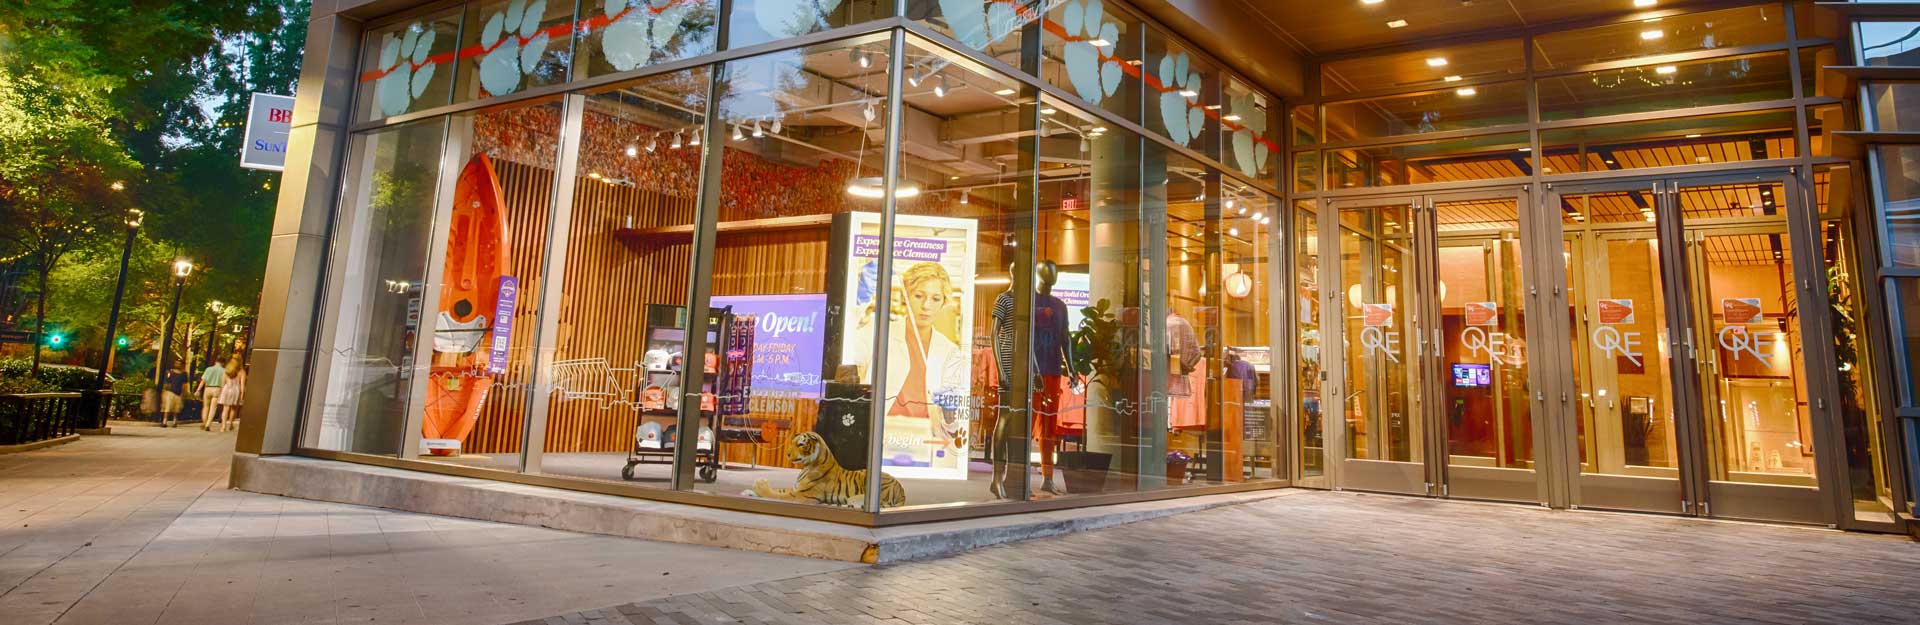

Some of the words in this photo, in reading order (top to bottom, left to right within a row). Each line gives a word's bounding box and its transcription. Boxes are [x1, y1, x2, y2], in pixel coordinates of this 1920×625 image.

[856, 236, 903, 247] Experce
[903, 239, 944, 250] Greatness
[855, 246, 903, 257] Experce
[903, 249, 938, 259] Clemson
[762, 311, 818, 338] Open!
[749, 399, 795, 413] CLEMSON
[938, 394, 985, 408] EXPERIENCE
